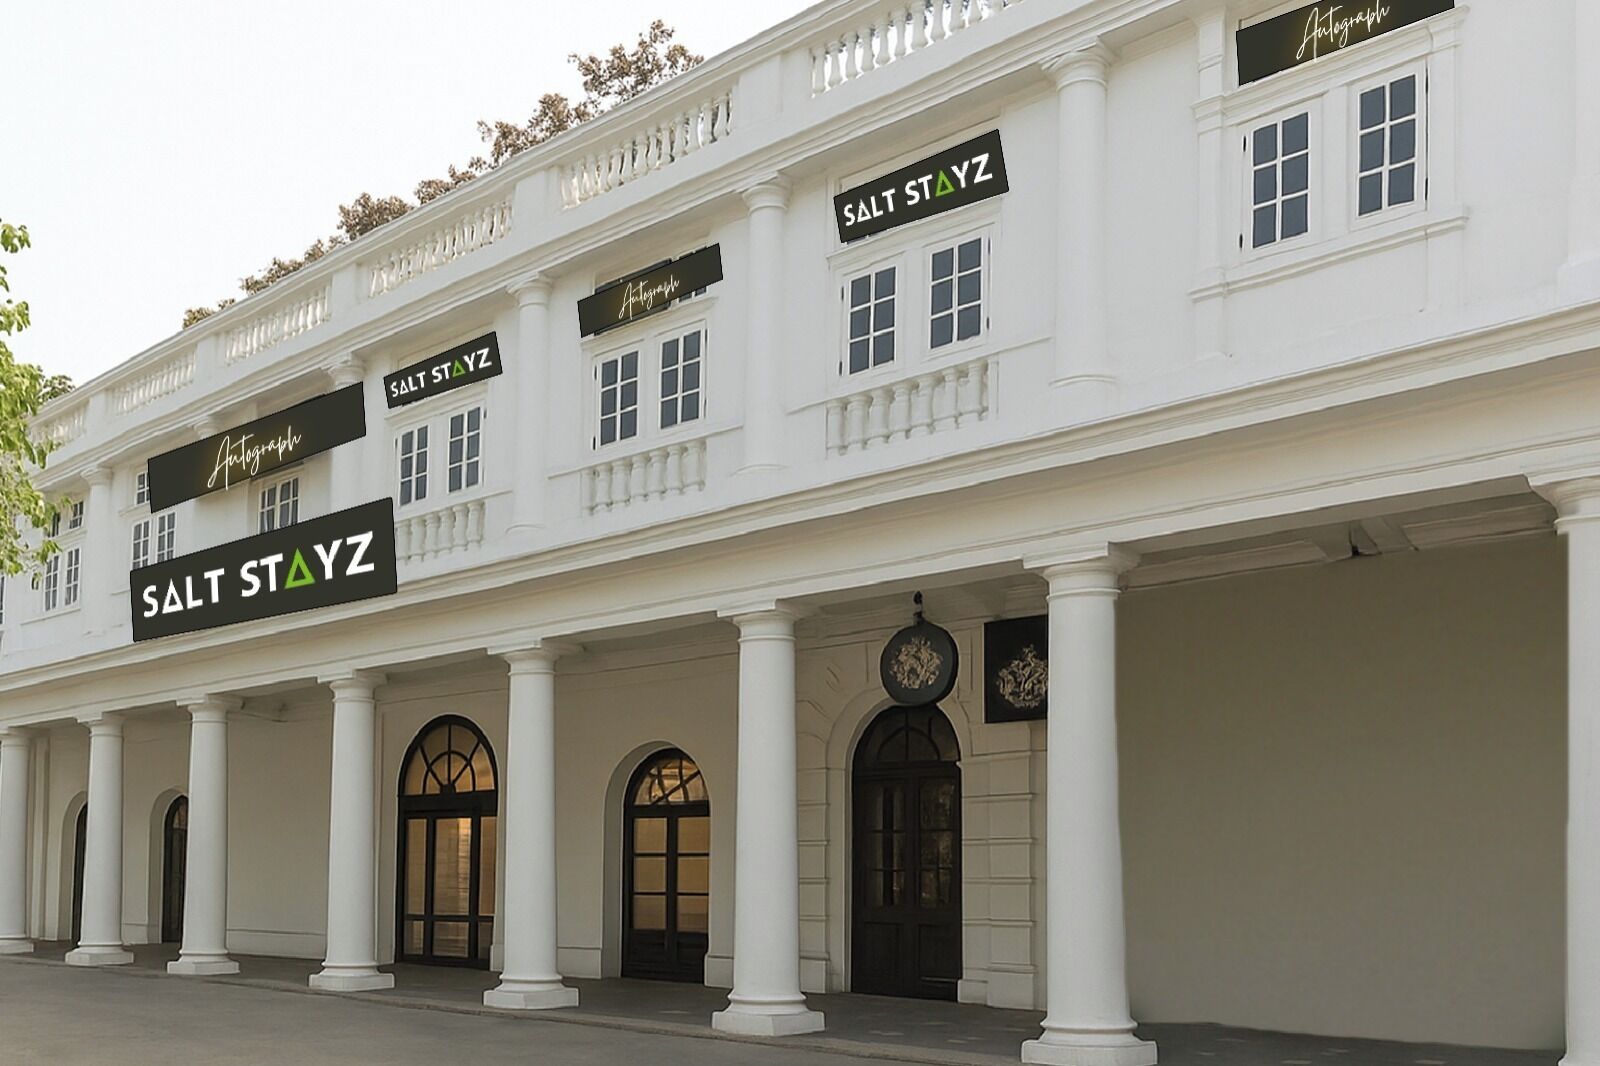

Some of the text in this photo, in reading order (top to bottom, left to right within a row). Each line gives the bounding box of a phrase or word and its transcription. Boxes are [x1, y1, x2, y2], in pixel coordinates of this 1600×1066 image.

[1296, 0, 1390, 62] Autograph
[843, 152, 993, 226] SALT STAYZ
[618, 274, 680, 319] Autograph
[390, 346, 492, 397] SALT STAYZ
[206, 424, 302, 490] Autograph
[142, 530, 375, 618] SALT STAYZ
